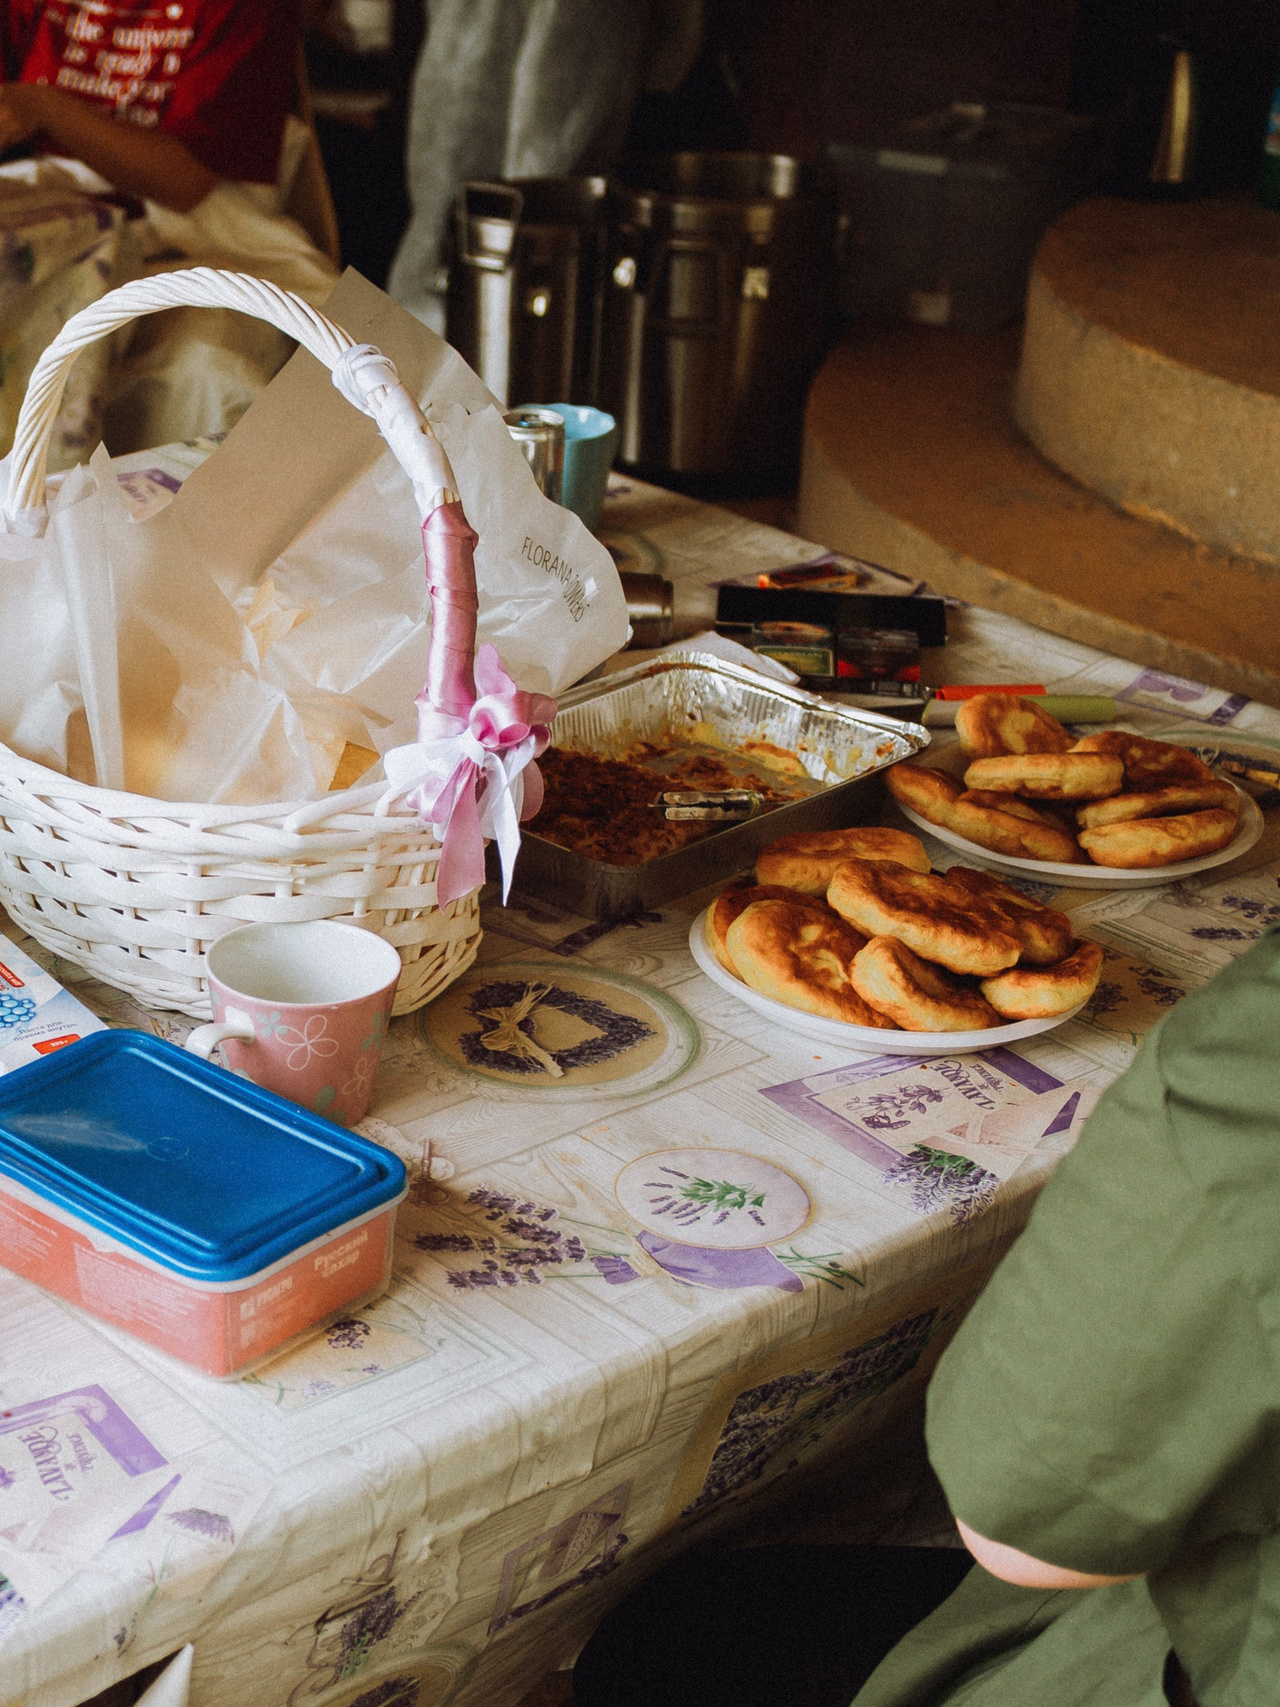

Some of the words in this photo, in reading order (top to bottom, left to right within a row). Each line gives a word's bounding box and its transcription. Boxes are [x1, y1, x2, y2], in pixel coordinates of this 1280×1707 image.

[521, 536, 573, 584] FLORANA
[18, 1023, 44, 1035] Паста
[46, 1020, 64, 1030] для
